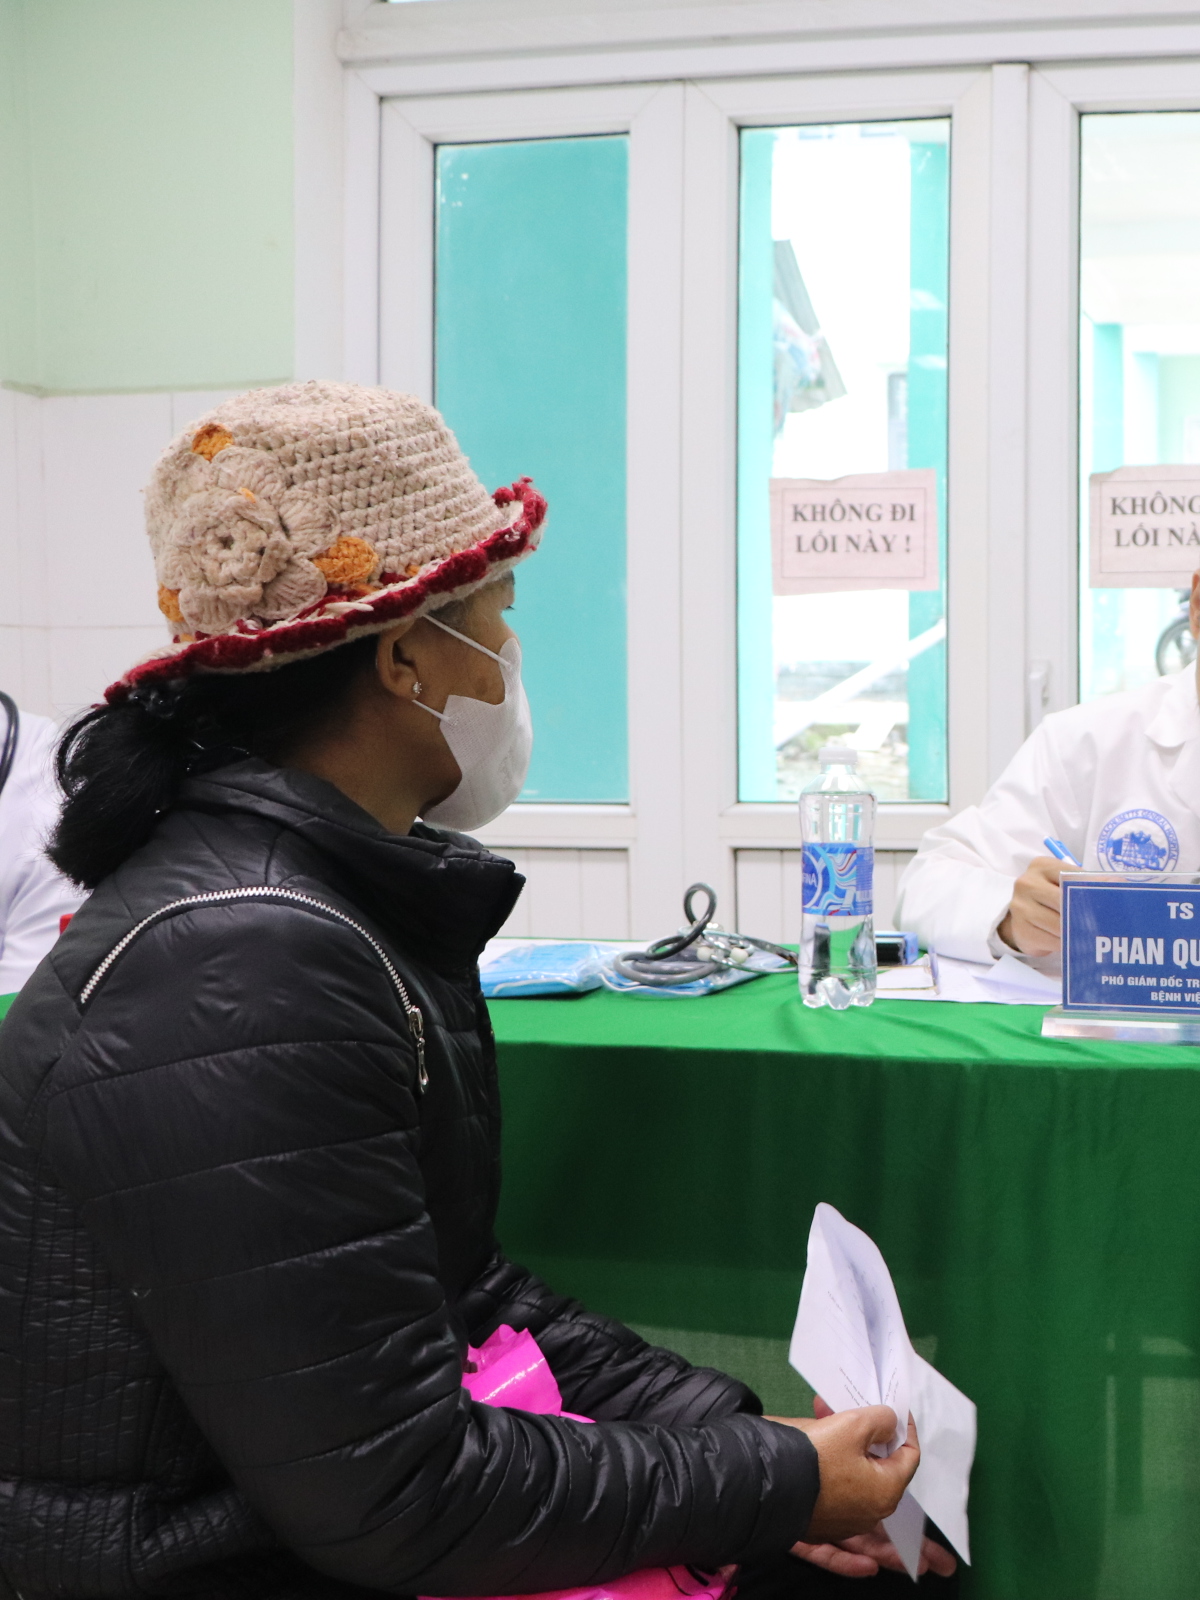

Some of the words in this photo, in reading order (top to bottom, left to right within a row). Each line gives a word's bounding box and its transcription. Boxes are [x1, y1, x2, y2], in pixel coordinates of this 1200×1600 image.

[792, 498, 883, 522] KHÔNG
[890, 503, 917, 522] ĐI
[795, 529, 839, 554] LỐI
[846, 529, 897, 553] NÀY
[1115, 522, 1160, 547] LỐI
[1166, 902, 1195, 920] TS
[1095, 936, 1164, 965] PHAN
[1101, 974, 1125, 986] PHÓ
[1127, 975, 1157, 987] GIÁM
[1160, 975, 1183, 988] ĐỐC
[1151, 990, 1182, 1003] BỆNH
